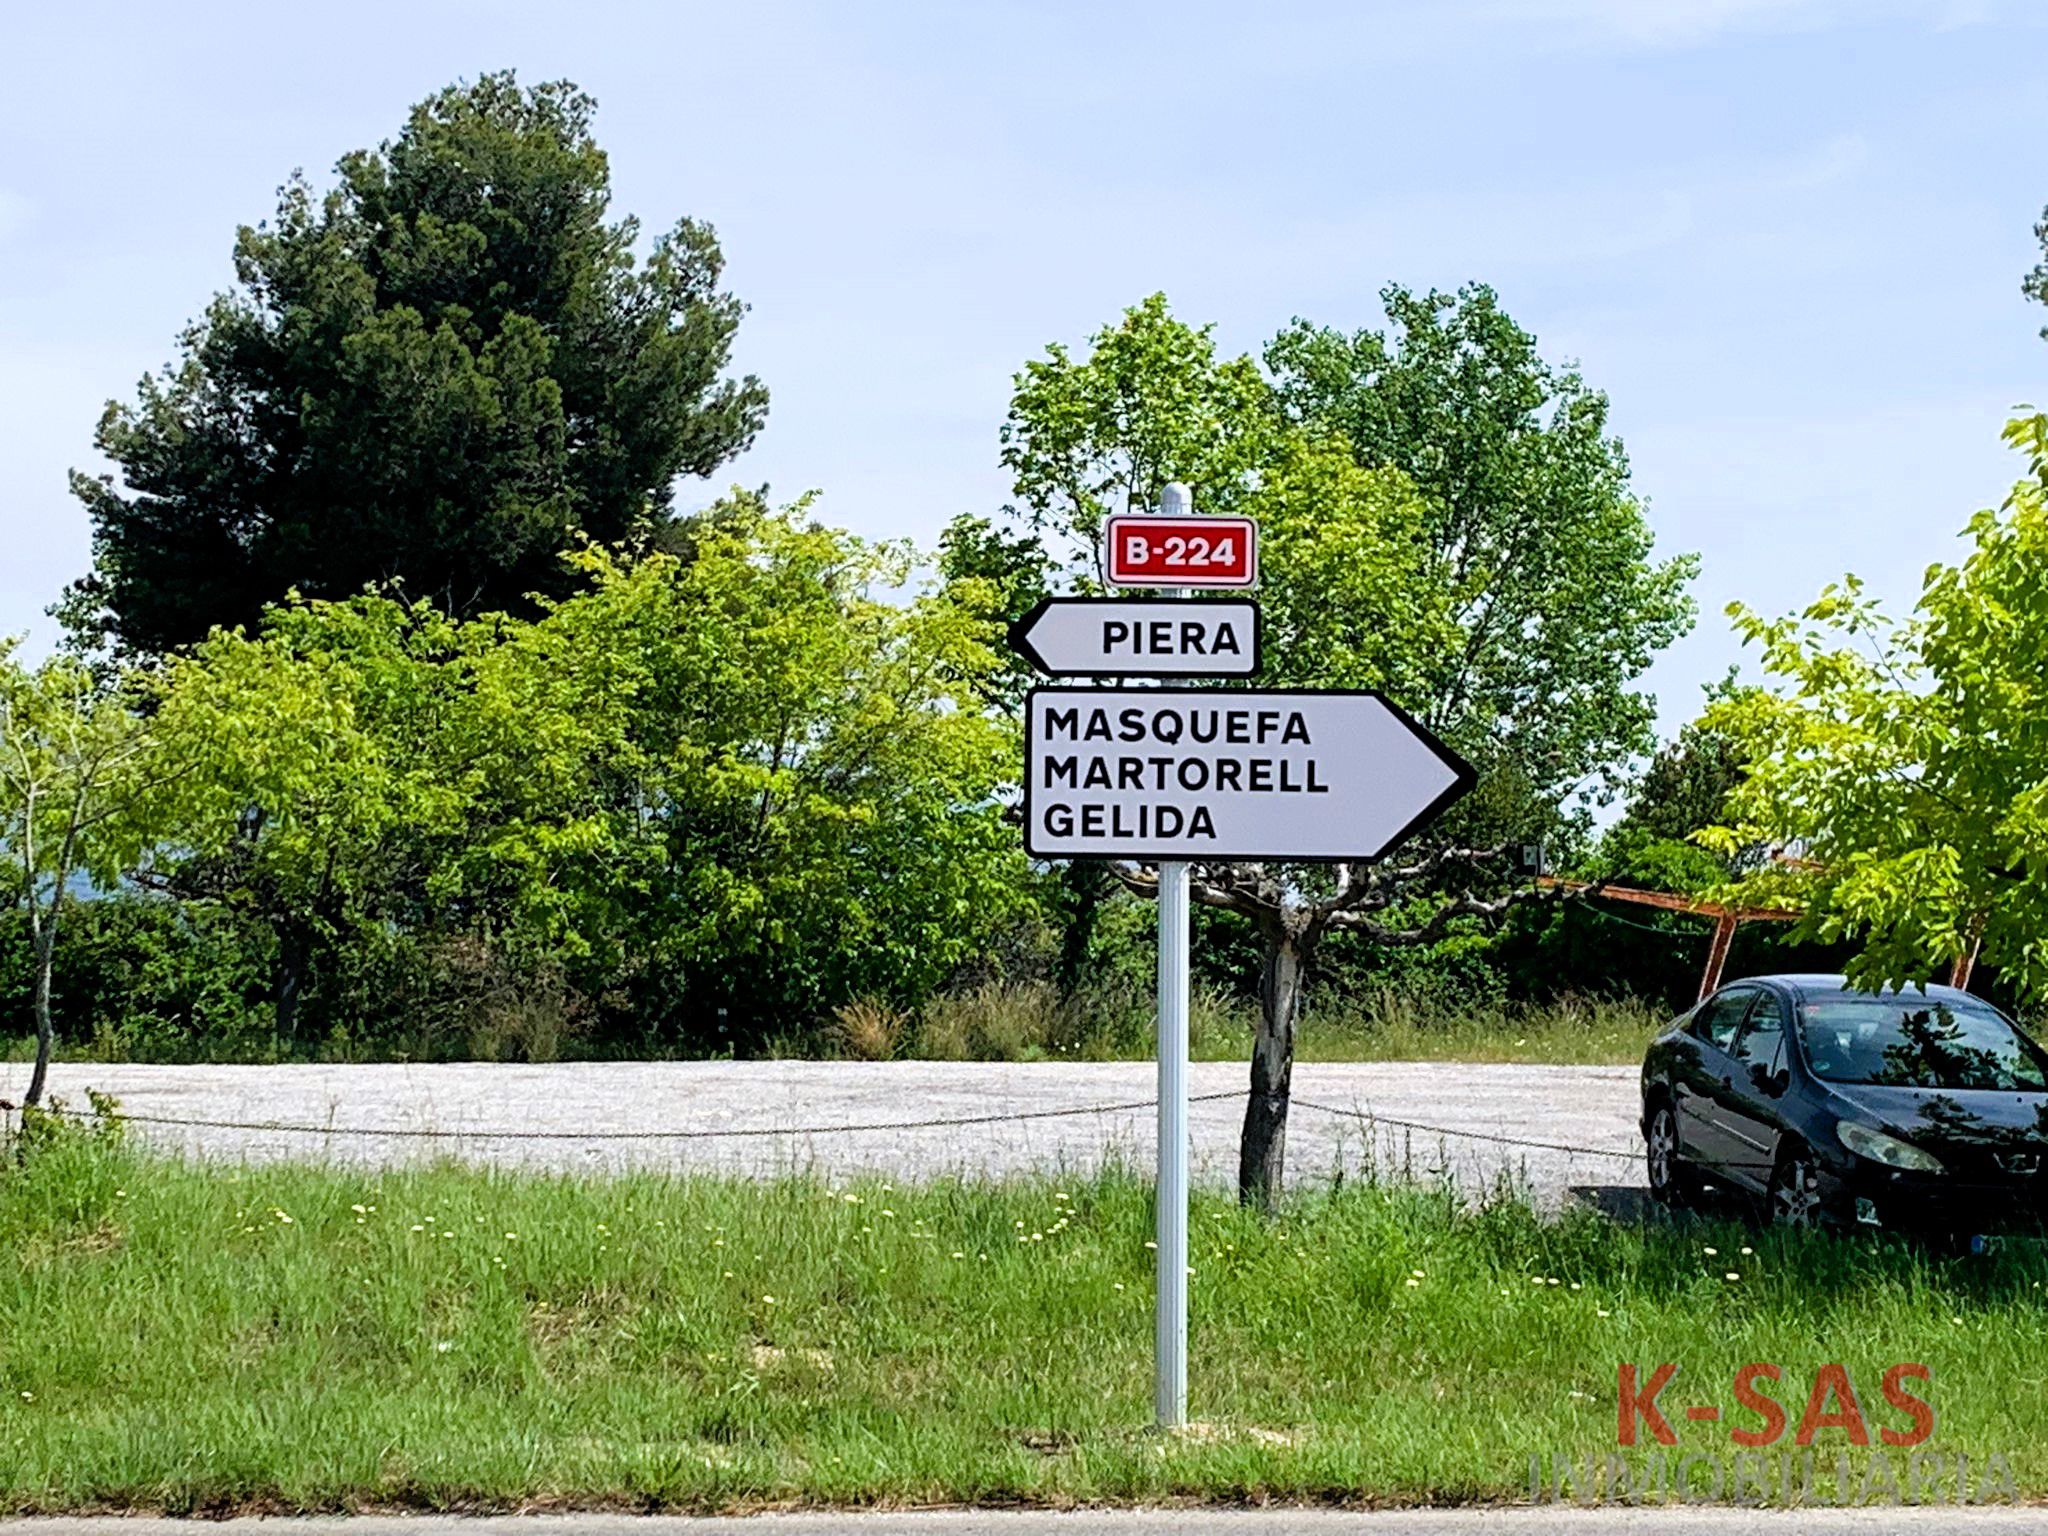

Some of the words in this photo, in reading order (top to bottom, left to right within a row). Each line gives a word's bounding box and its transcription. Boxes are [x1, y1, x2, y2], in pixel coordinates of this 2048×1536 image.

[1125, 536, 1236, 567] B-224
[1102, 621, 1241, 655] PIERA
[1044, 707, 1311, 746] MASQUEFA
[1043, 755, 1329, 793] MARTORELL
[1043, 803, 1217, 840] GELIDA
